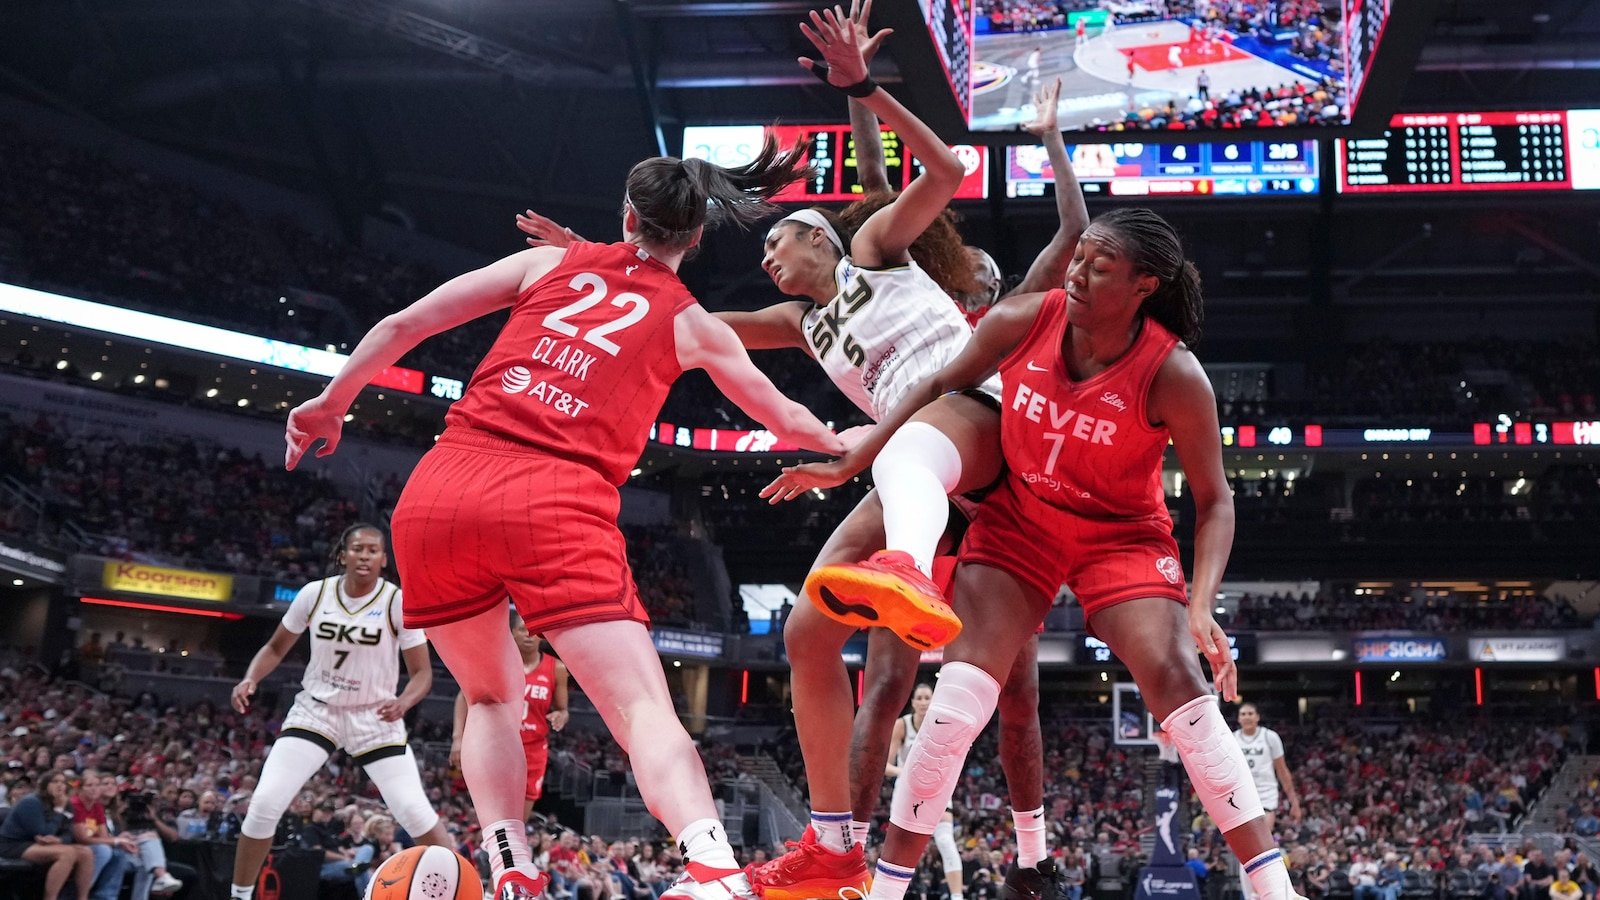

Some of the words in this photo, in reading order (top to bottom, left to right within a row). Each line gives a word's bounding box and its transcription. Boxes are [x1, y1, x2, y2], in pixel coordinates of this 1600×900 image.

[541, 272, 650, 357] 22
[812, 273, 873, 360] SKY
[531, 336, 597, 381] CLARK
[843, 333, 865, 367] 5
[527, 380, 589, 418] AT&T
[1012, 382, 1118, 446] FEVER
[1100, 391, 1127, 412] Lilly
[1043, 432, 1066, 476] 7
[116, 563, 216, 590] Koorsen
[315, 621, 383, 646] SKY
[333, 650, 350, 670] 7
